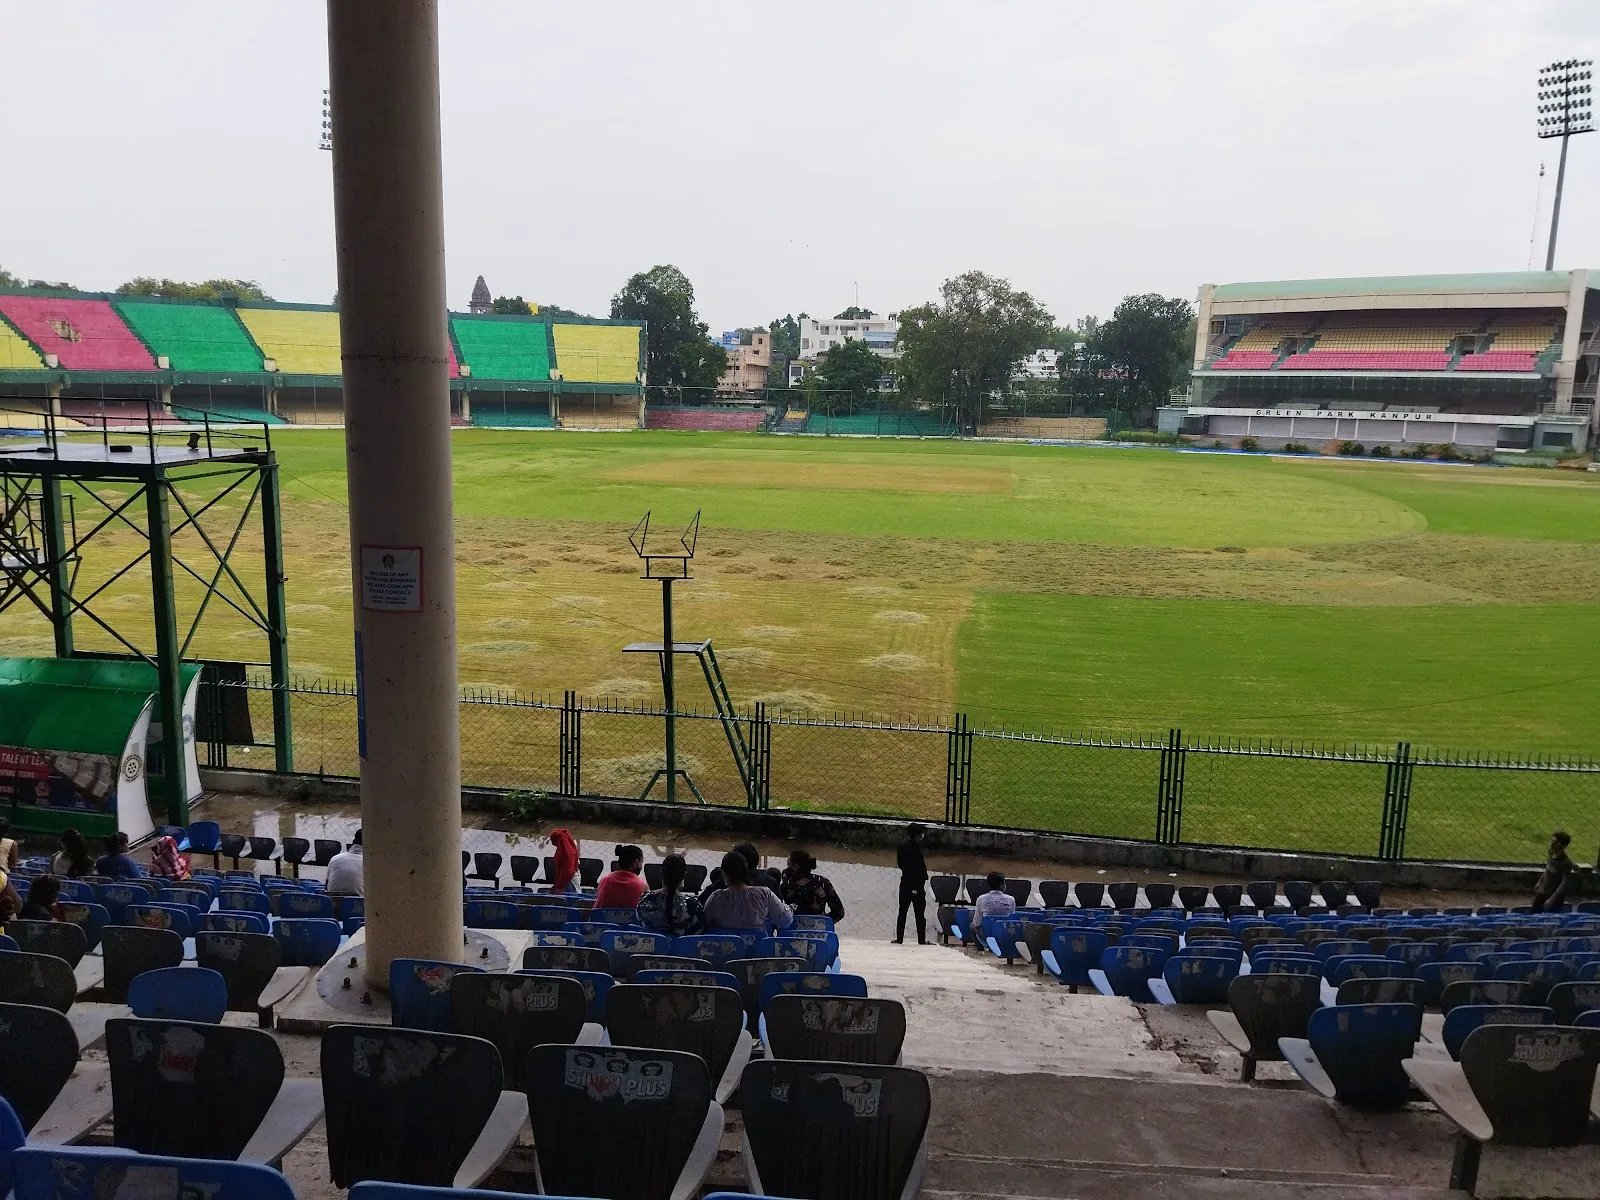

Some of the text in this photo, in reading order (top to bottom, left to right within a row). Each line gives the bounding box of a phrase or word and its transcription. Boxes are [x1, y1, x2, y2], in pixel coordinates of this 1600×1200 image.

[1256, 409, 1302, 417] GREEN
[1369, 412, 1433, 421] KANPUR
[1, 753, 30, 764] TALENT
[625, 1079, 668, 1097] PLUS
